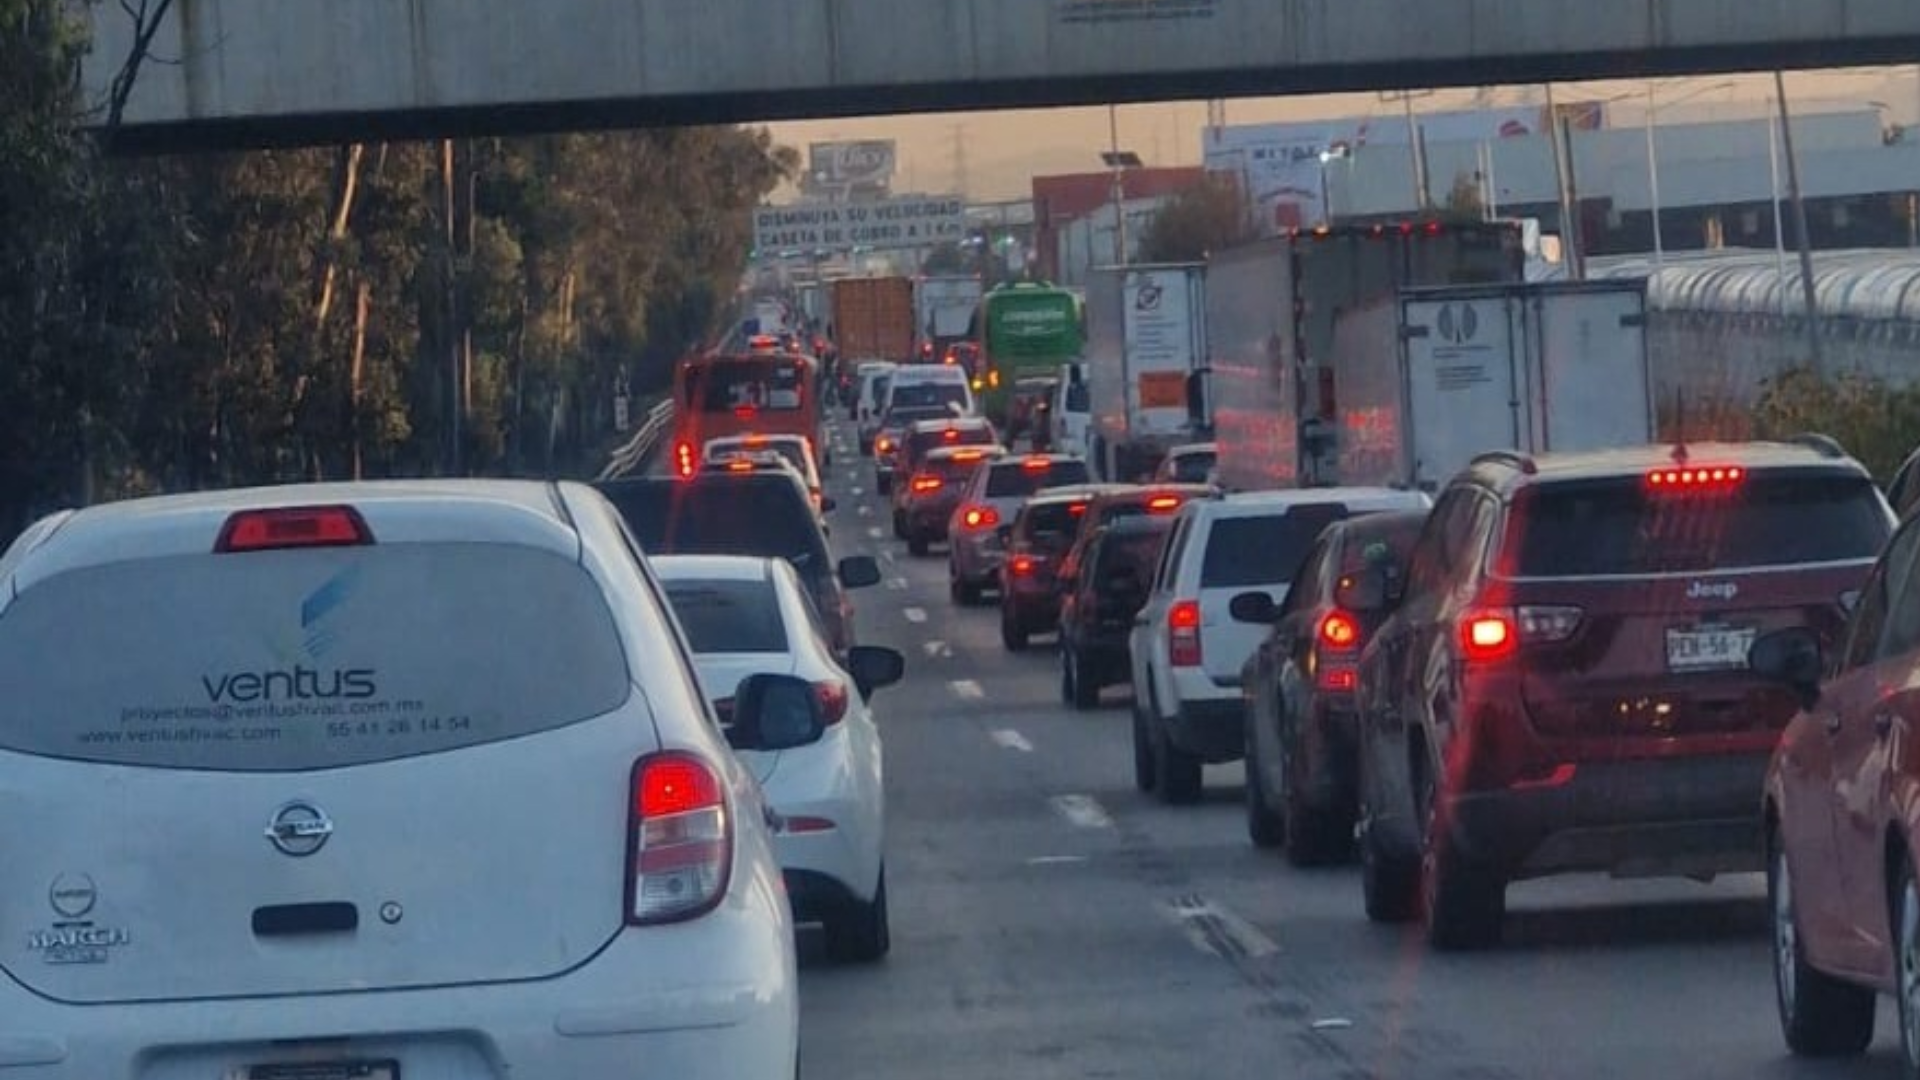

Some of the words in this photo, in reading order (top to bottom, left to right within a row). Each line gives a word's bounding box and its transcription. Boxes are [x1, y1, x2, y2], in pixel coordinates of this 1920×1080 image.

[758, 208, 839, 228] DISMINUYA
[847, 206, 868, 222] SU
[876, 200, 960, 221] VELOCIDAD
[760, 228, 817, 246] CASETA
[824, 227, 841, 243] DE
[852, 224, 900, 242] COBRO
[907, 224, 917, 237] A
[1686, 582, 1738, 601] Jeep
[203, 665, 376, 701] ventus
[327, 721, 350, 738] 55
[356, 720, 380, 736] 41
[421, 716, 441, 733] 14
[448, 714, 470, 731] 54
